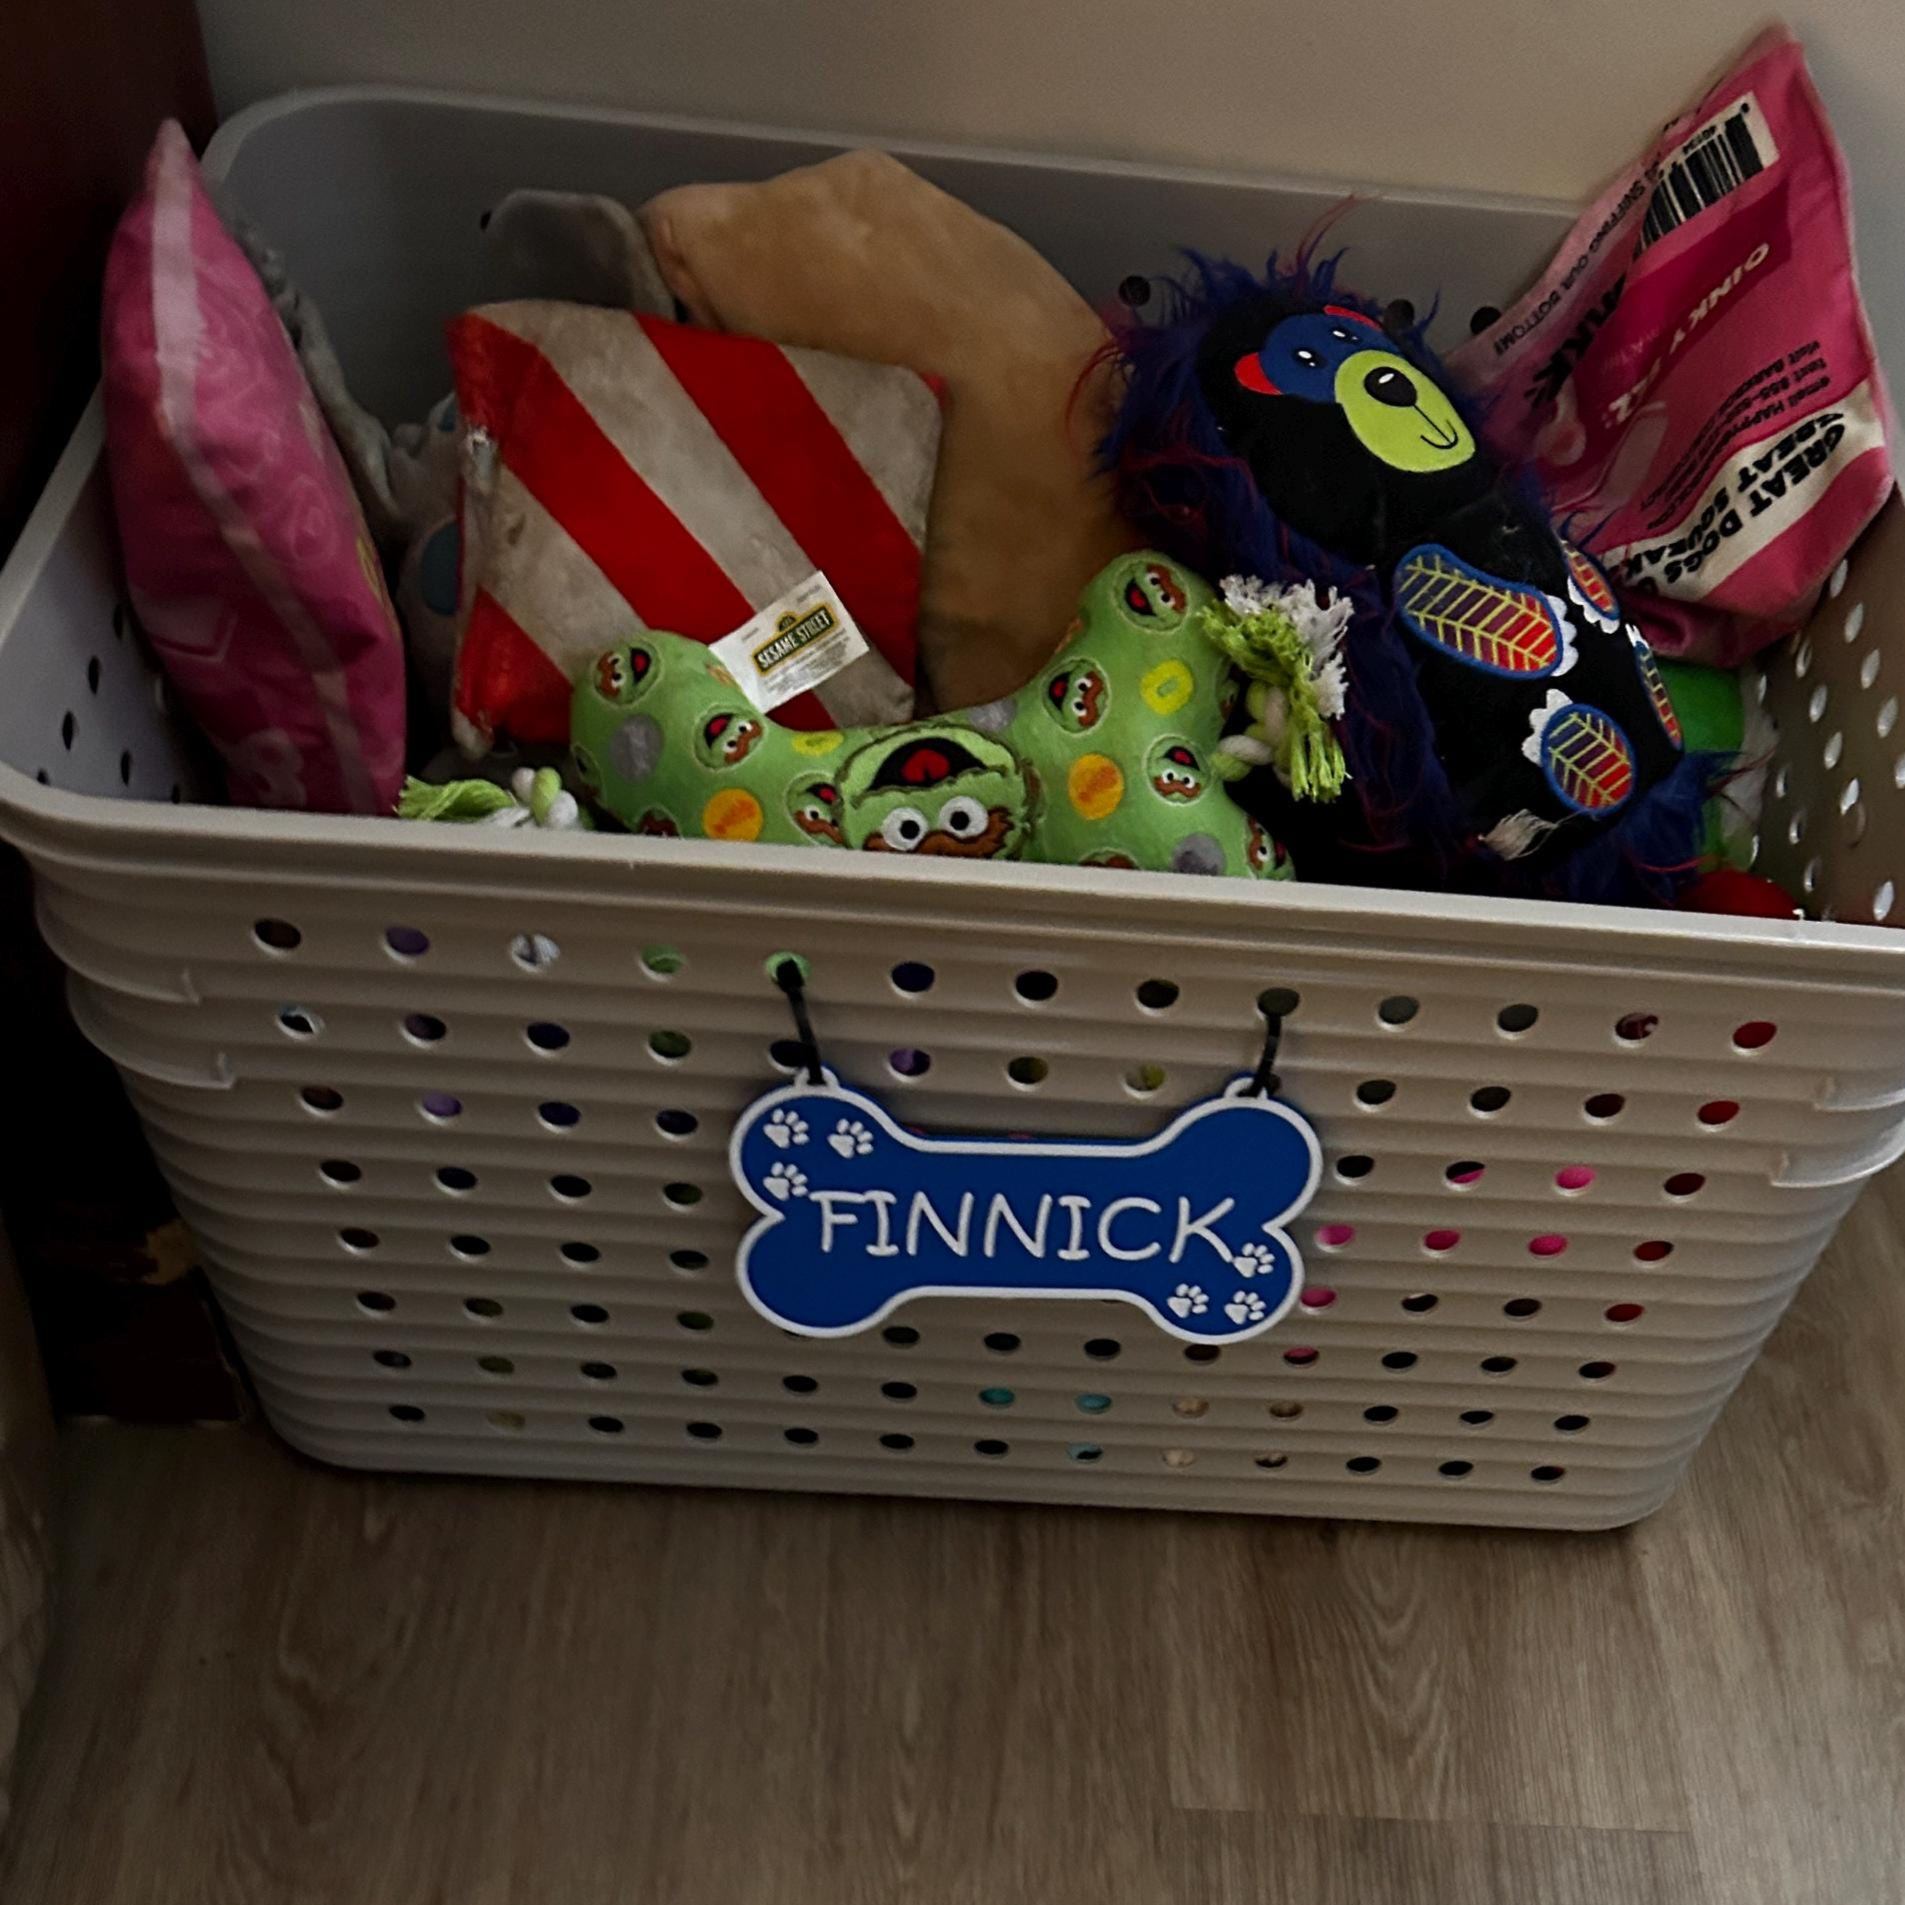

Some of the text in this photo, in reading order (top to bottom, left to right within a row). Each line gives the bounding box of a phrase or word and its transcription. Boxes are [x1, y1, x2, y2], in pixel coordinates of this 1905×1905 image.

[1560, 253, 1590, 291] OUR
[1669, 242, 1770, 356] OINKY
[1750, 424, 1846, 517] GREAT
[1663, 508, 1744, 584] DOGS
[756, 632, 801, 670] SESAME
[798, 609, 831, 644] STREET
[809, 1190, 1235, 1263] FINNICK
